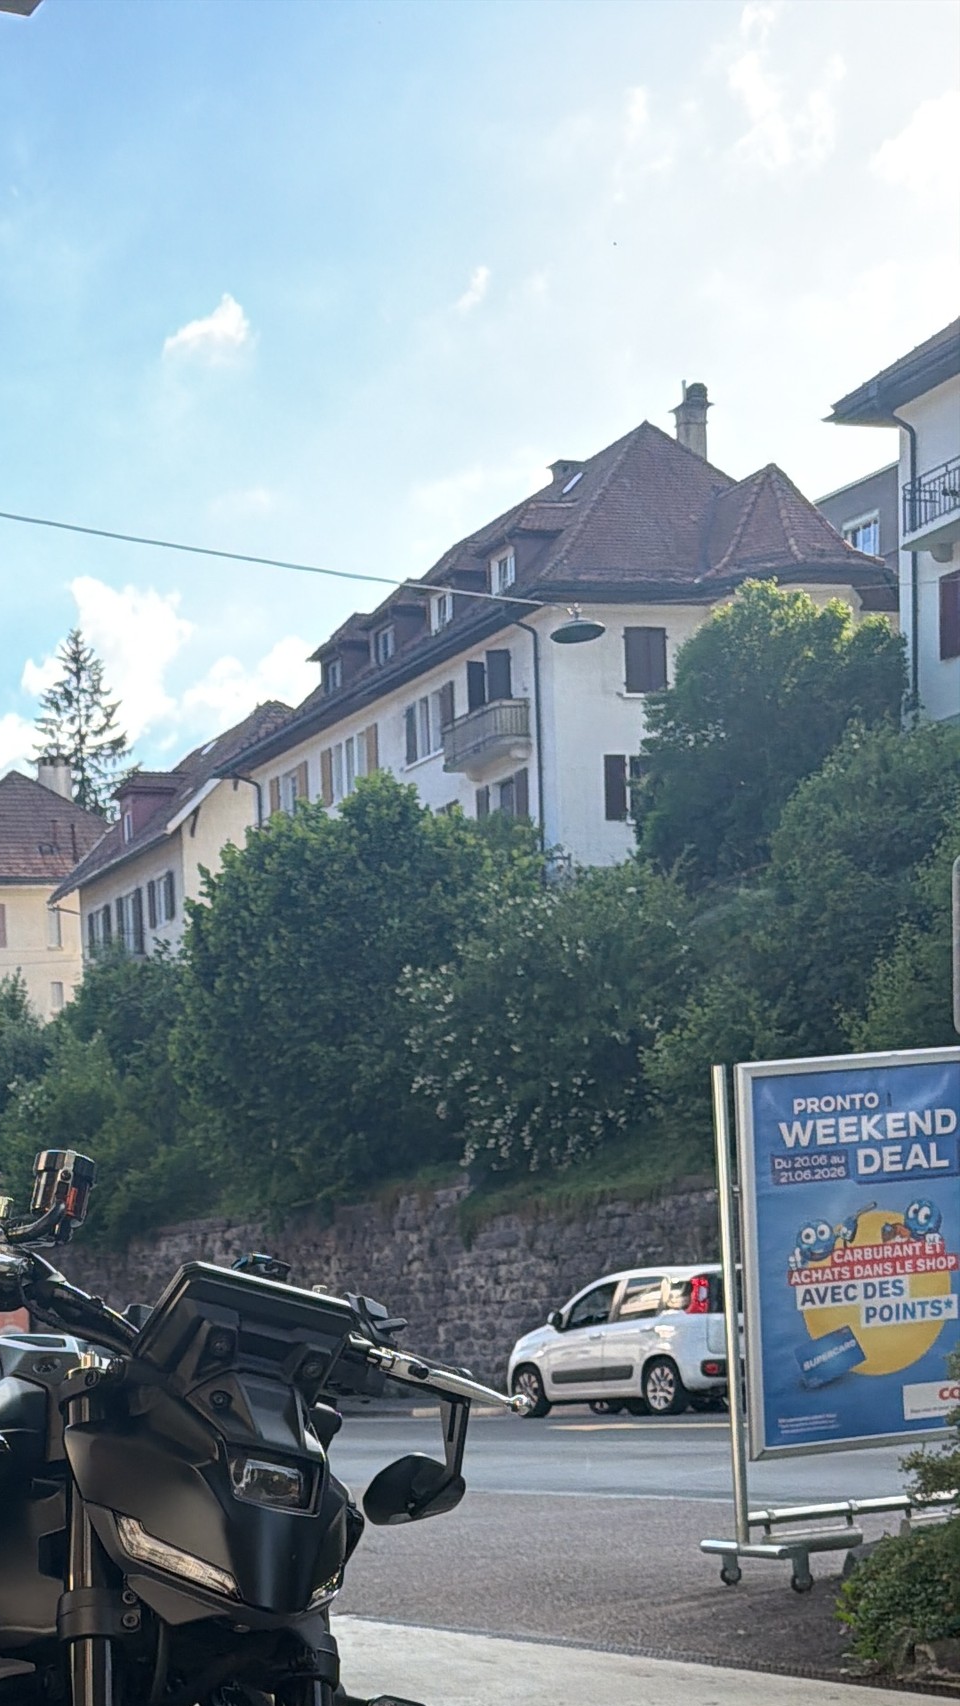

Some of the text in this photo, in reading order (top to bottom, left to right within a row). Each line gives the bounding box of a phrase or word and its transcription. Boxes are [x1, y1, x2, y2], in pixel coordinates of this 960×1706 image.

[793, 1092, 879, 1115] PRONTO
[778, 1108, 957, 1148] WEEKEND
[774, 1158, 791, 1169] Du
[830, 1155, 845, 1164] au
[857, 1142, 949, 1175] DEAL
[833, 1242, 942, 1263] CARBURANT ET
[790, 1255, 956, 1285] ACHATS DANS LE SHOP
[801, 1278, 904, 1306] AVEC DES
